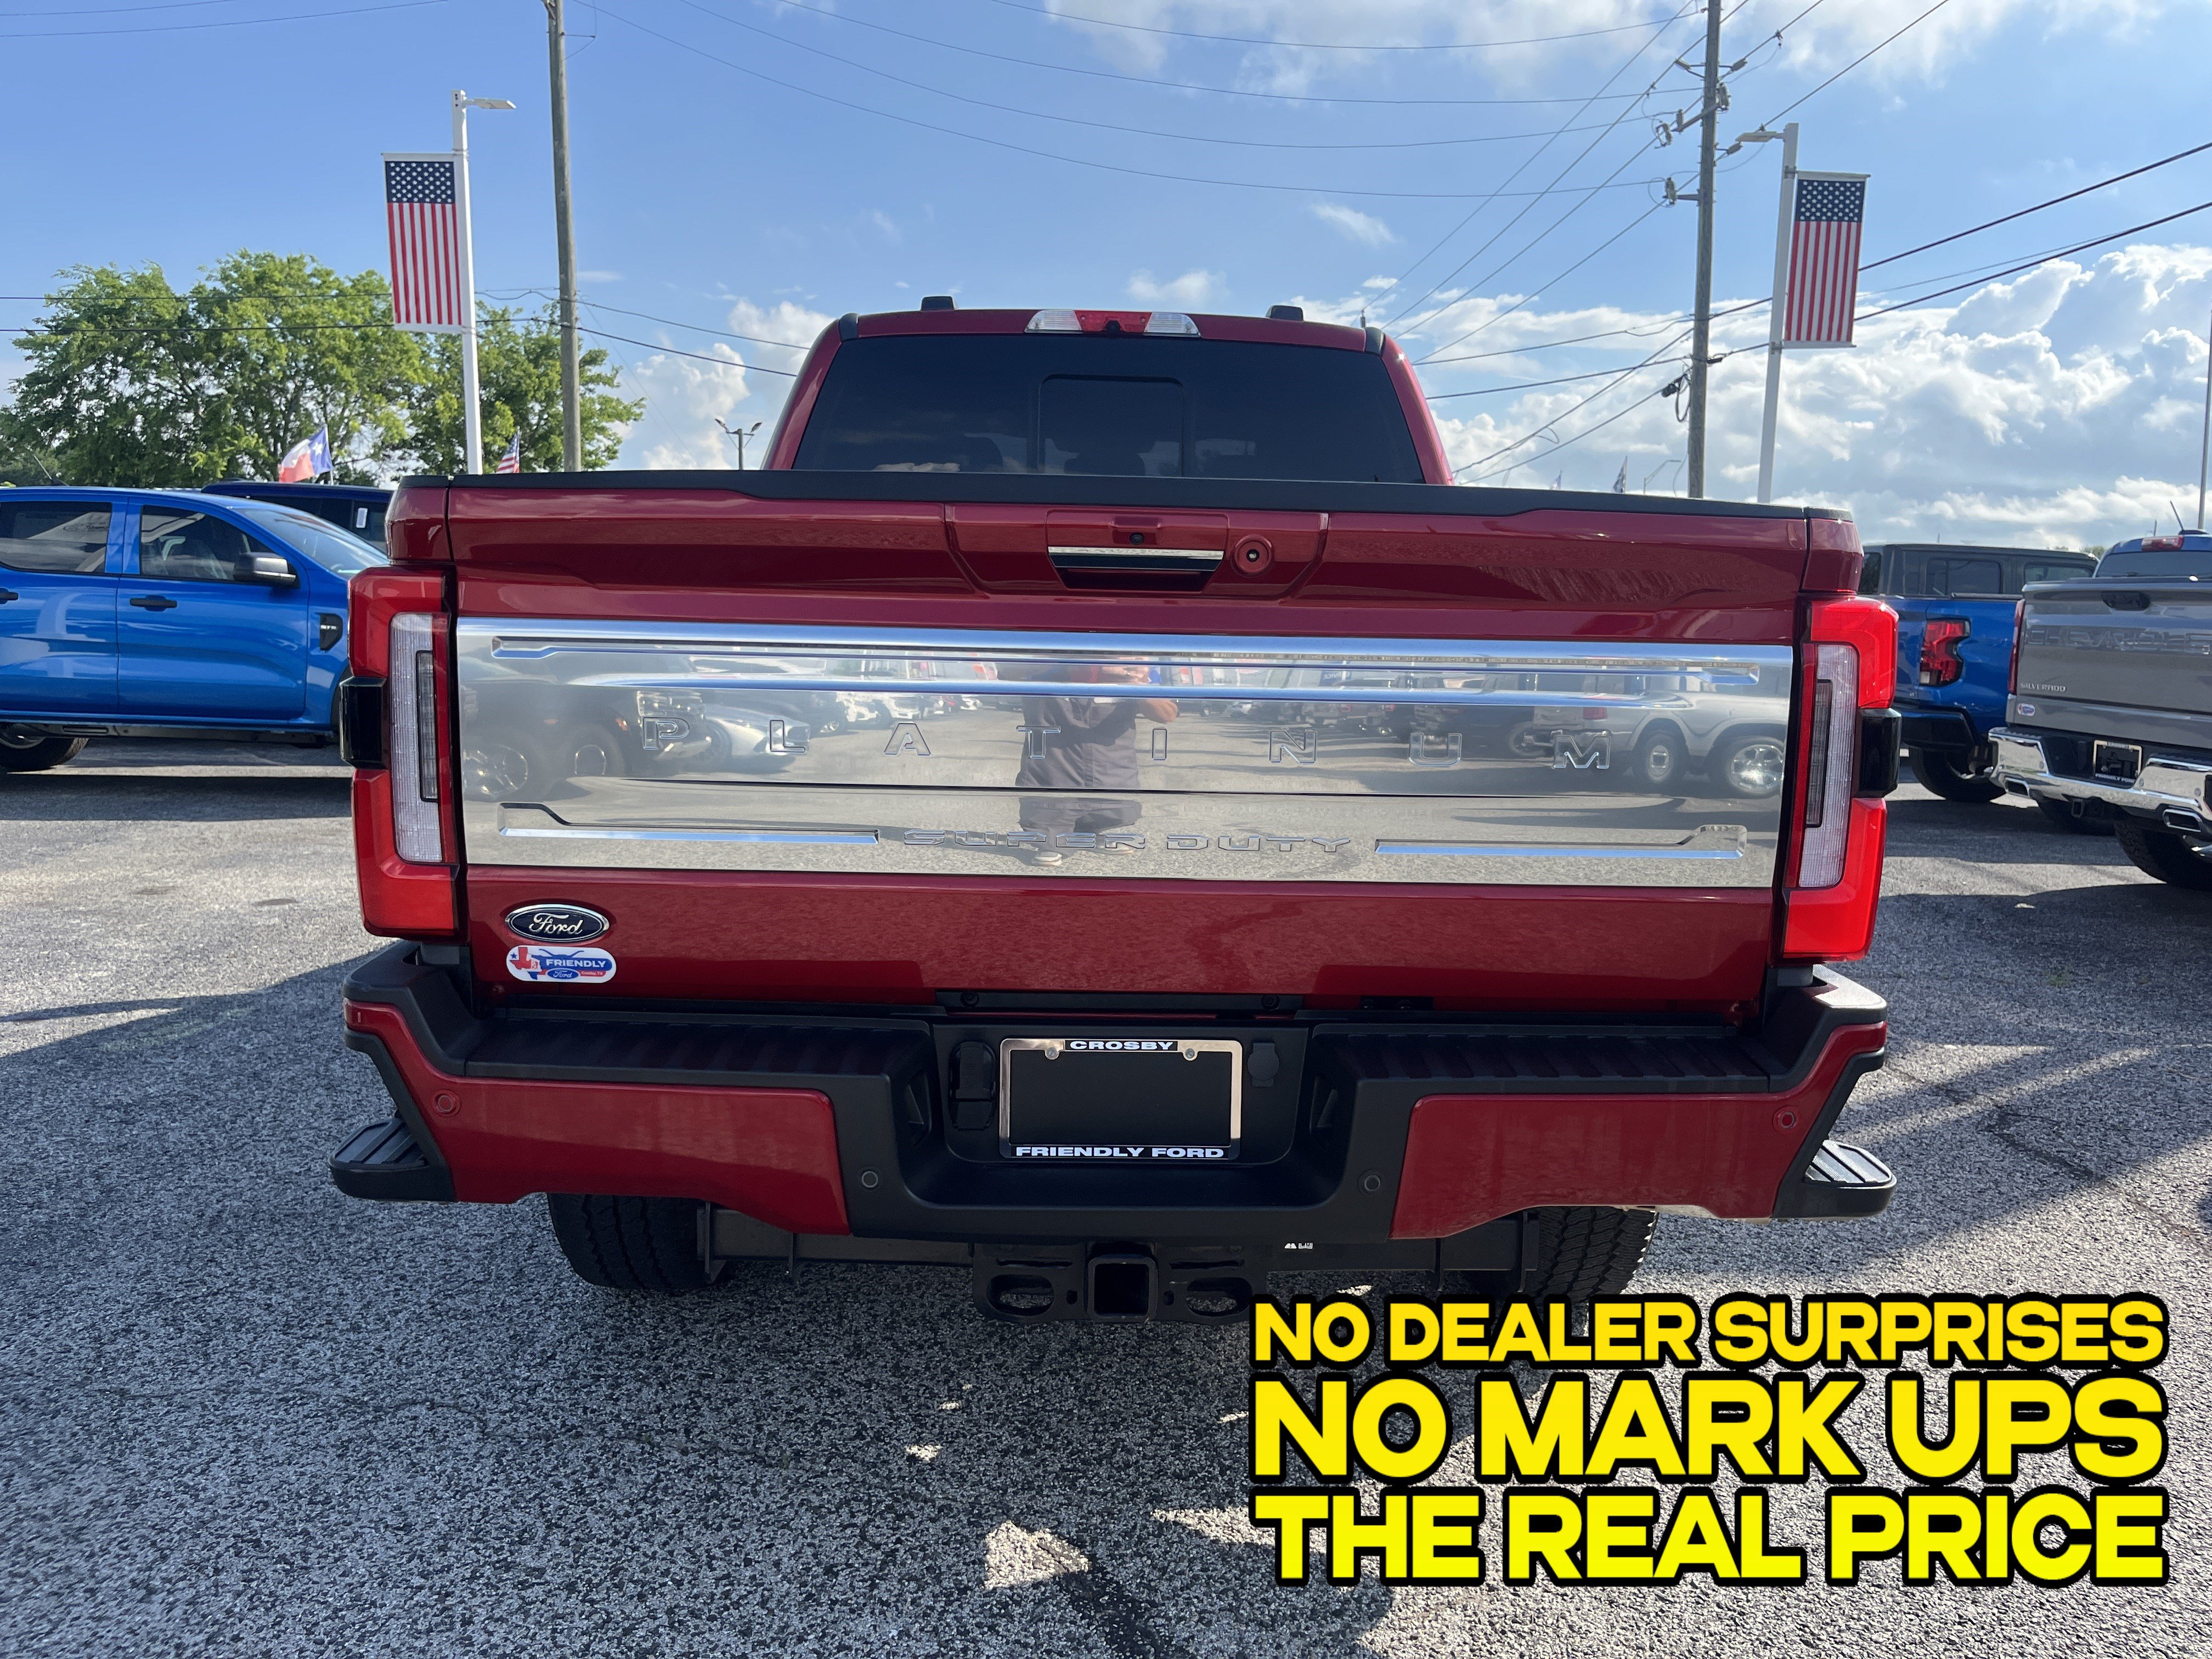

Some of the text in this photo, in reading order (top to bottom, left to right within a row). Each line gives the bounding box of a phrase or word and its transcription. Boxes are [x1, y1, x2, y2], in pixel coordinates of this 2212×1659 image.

[2020, 682, 2067, 692] SILVERADO
[642, 716, 1611, 769] PLATINUM
[904, 830, 1351, 853] SUPER DUTY
[528, 912, 583, 934] Ford
[546, 958, 606, 968] FRIENDLY
[552, 970, 573, 978] Ford
[1069, 1041, 1173, 1051] CROSBY
[1016, 1147, 1224, 1158] FRIENDLY FORD
